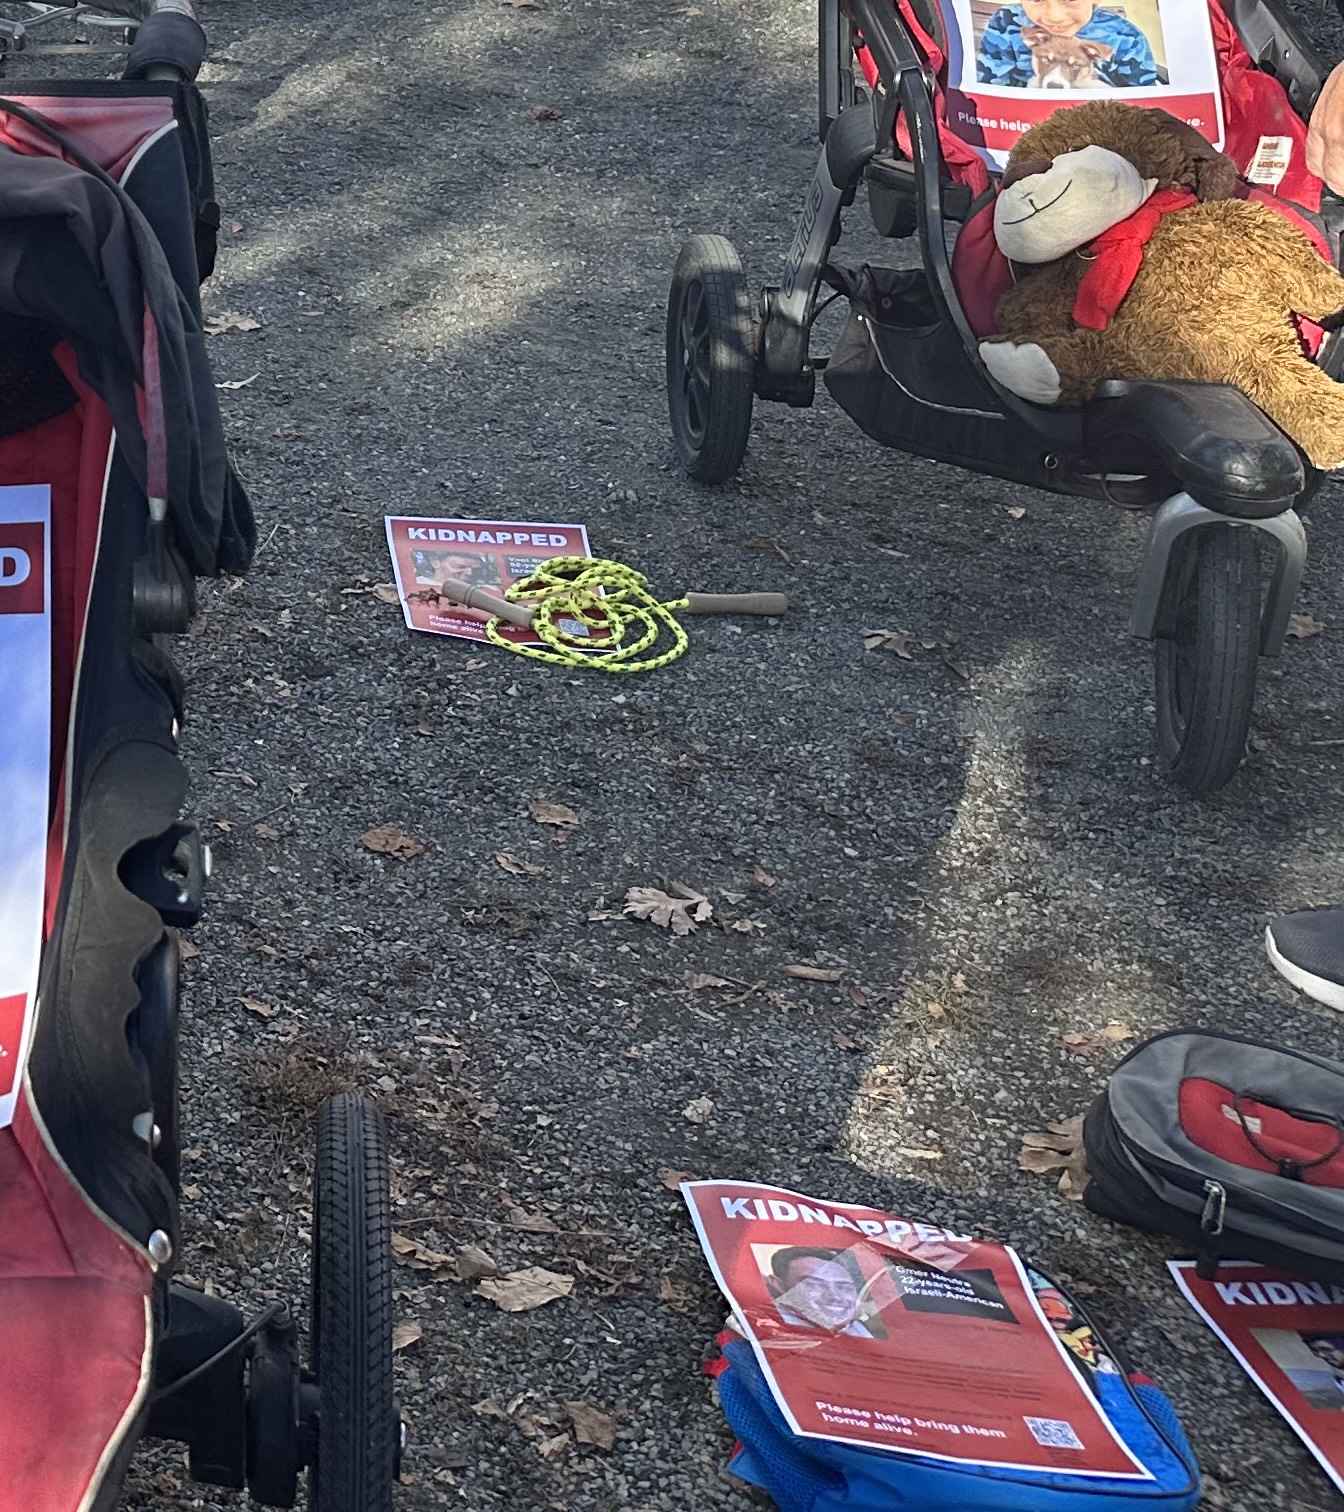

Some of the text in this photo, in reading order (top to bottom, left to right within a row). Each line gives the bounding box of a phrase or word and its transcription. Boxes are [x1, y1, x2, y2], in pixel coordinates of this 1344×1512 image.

[958, 110, 998, 130] Please
[406, 526, 568, 548] KIDNAPPED
[720, 1196, 973, 1243] KIDNAPPED
[899, 1275, 976, 1297] 22-years-old
[903, 1285, 1005, 1310] Israeli-American
[1214, 1281, 1344, 1306] KIDNA
[815, 1400, 1007, 1439] Please help bring them
[821, 1412, 919, 1438] home alive.
